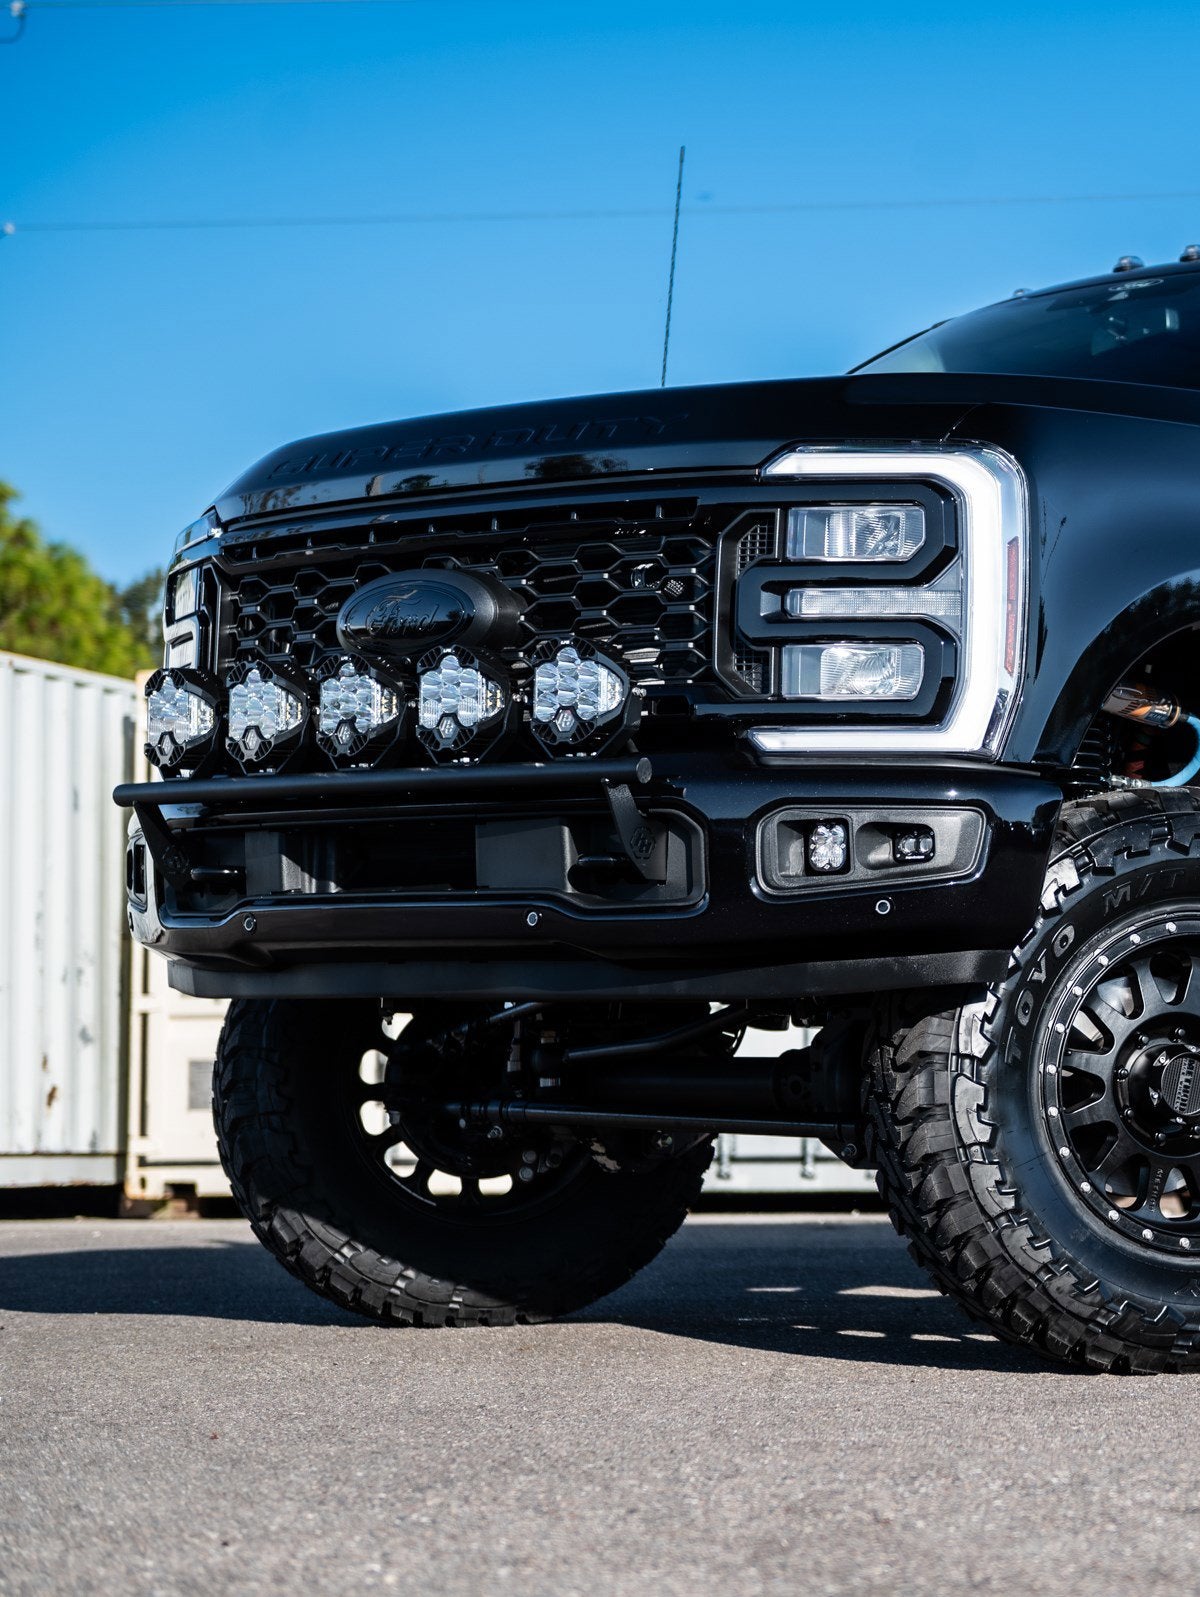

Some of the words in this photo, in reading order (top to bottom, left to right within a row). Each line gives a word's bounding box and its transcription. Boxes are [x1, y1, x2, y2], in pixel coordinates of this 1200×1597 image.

[268, 435, 476, 480] SUPER
[483, 413, 688, 451] DUTY
[365, 589, 440, 637] Ford
[1101, 868, 1187, 918] M/T
[1004, 922, 1076, 1065] TOYO
[1178, 1058, 1196, 1112] METHOD
